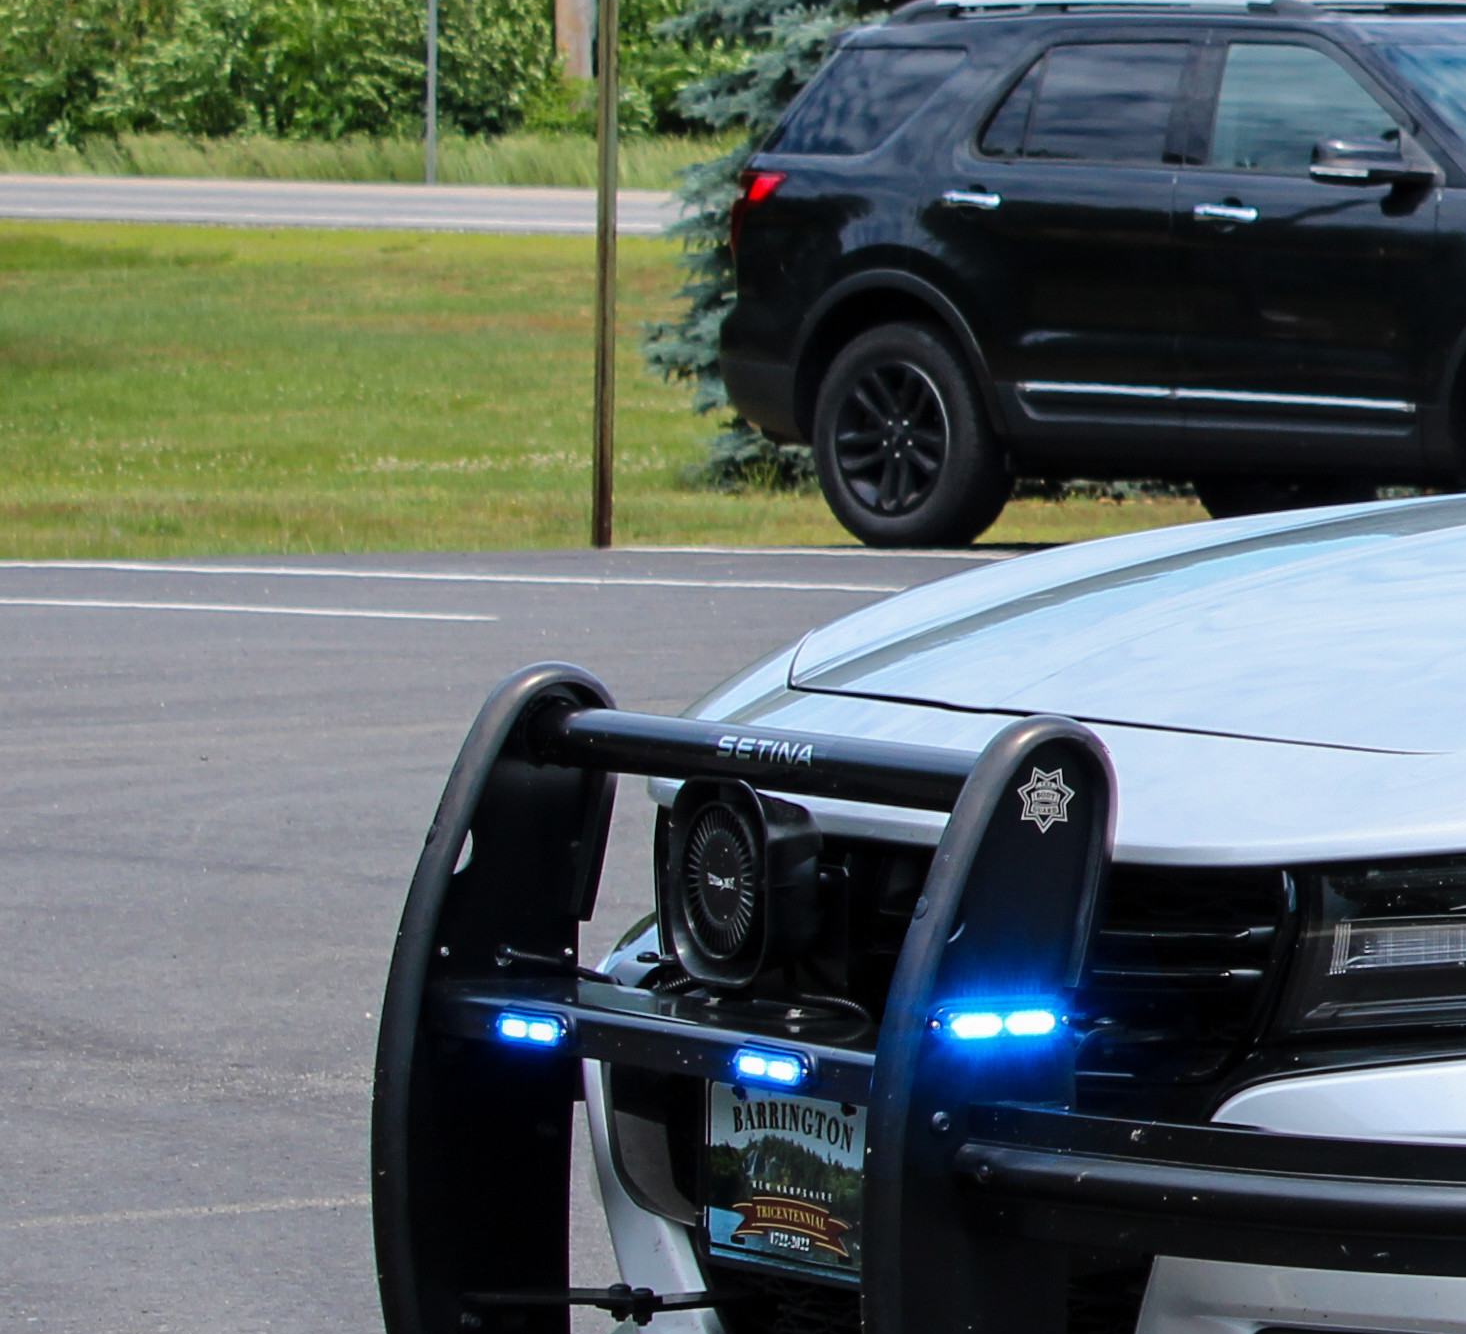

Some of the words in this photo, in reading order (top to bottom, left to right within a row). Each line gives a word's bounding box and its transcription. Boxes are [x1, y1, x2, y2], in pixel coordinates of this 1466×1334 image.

[716, 735, 814, 767] SETINA
[733, 1100, 854, 1154] BARRINGTON
[752, 1179, 771, 1191] NEW
[777, 1184, 832, 1203] HAMPSHIRE
[756, 1205, 826, 1231] TRICENTENNIAL
[769, 1231, 810, 1252] 1722-2022
